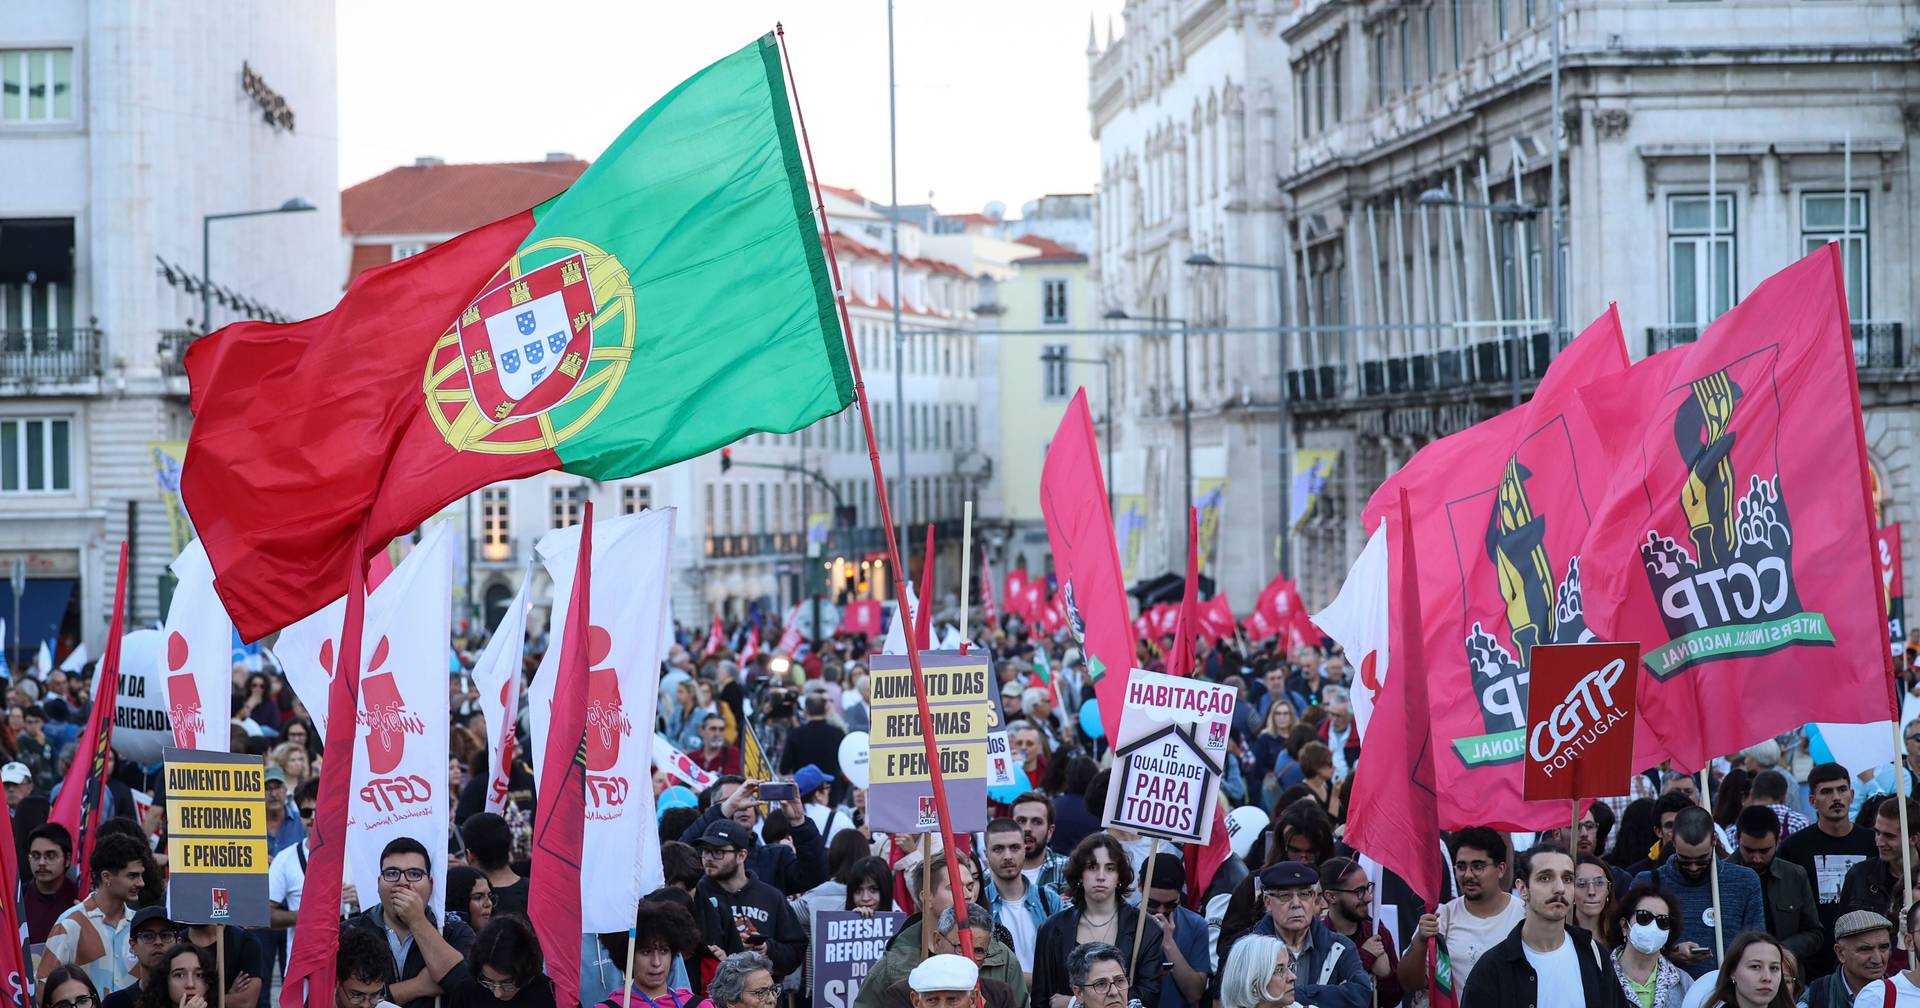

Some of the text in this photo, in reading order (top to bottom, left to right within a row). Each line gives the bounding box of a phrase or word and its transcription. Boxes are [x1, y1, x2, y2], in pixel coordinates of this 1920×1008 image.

[128, 675, 145, 698] DA
[952, 671, 984, 695] DAS
[1129, 682, 1234, 717] HABITAÇÃO
[1529, 658, 1626, 762] CGTP
[886, 711, 971, 738] REFOMAS
[1163, 743, 1179, 759] DE
[1542, 707, 1628, 778] PORTUGAL
[887, 754, 895, 776] E
[899, 747, 969, 776] PENÕES
[1133, 755, 1203, 781] QUALIDADE
[169, 768, 261, 792] AUMENTO DAS
[1135, 773, 1189, 805] PARA
[181, 806, 252, 830] REFORMAS
[1127, 797, 1192, 831] TODOS
[184, 842, 253, 868] E PENSÕES
[827, 917, 894, 941] DEFESA E
[851, 962, 868, 977] DO
